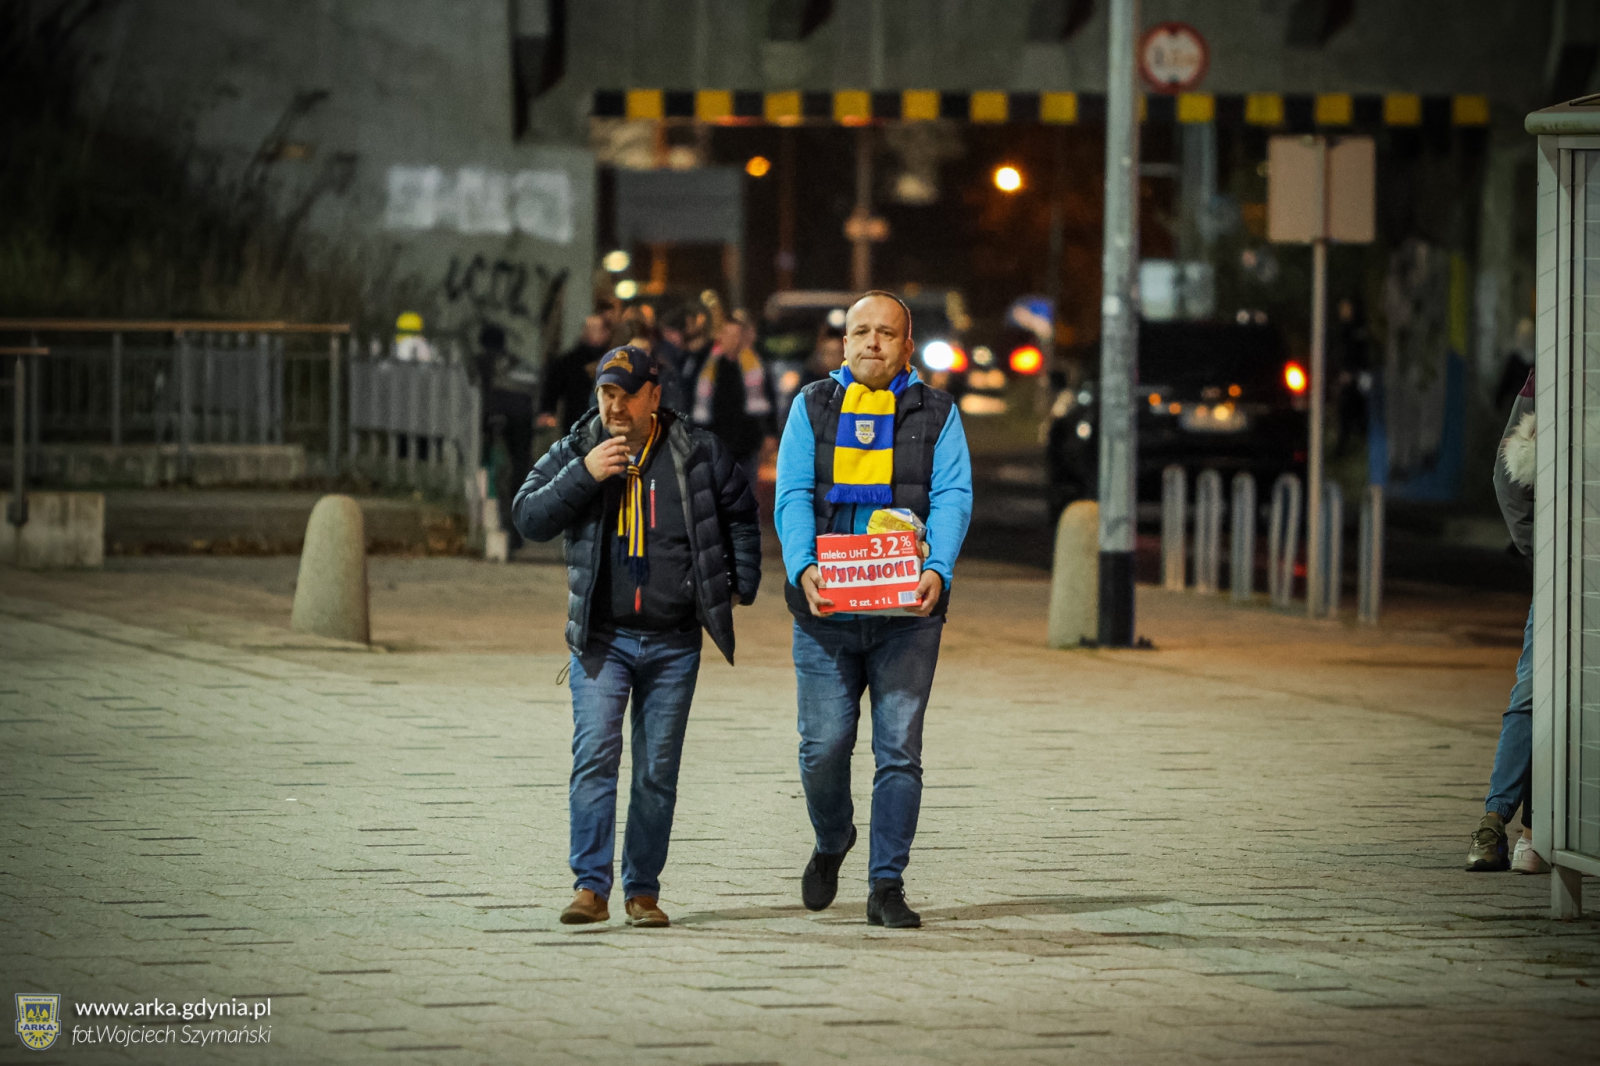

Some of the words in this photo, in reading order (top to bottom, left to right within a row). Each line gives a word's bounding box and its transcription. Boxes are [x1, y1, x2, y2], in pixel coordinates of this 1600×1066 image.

[821, 550, 847, 559] mleko
[849, 549, 868, 558] UHT
[820, 560, 917, 583] WYPASIONE
